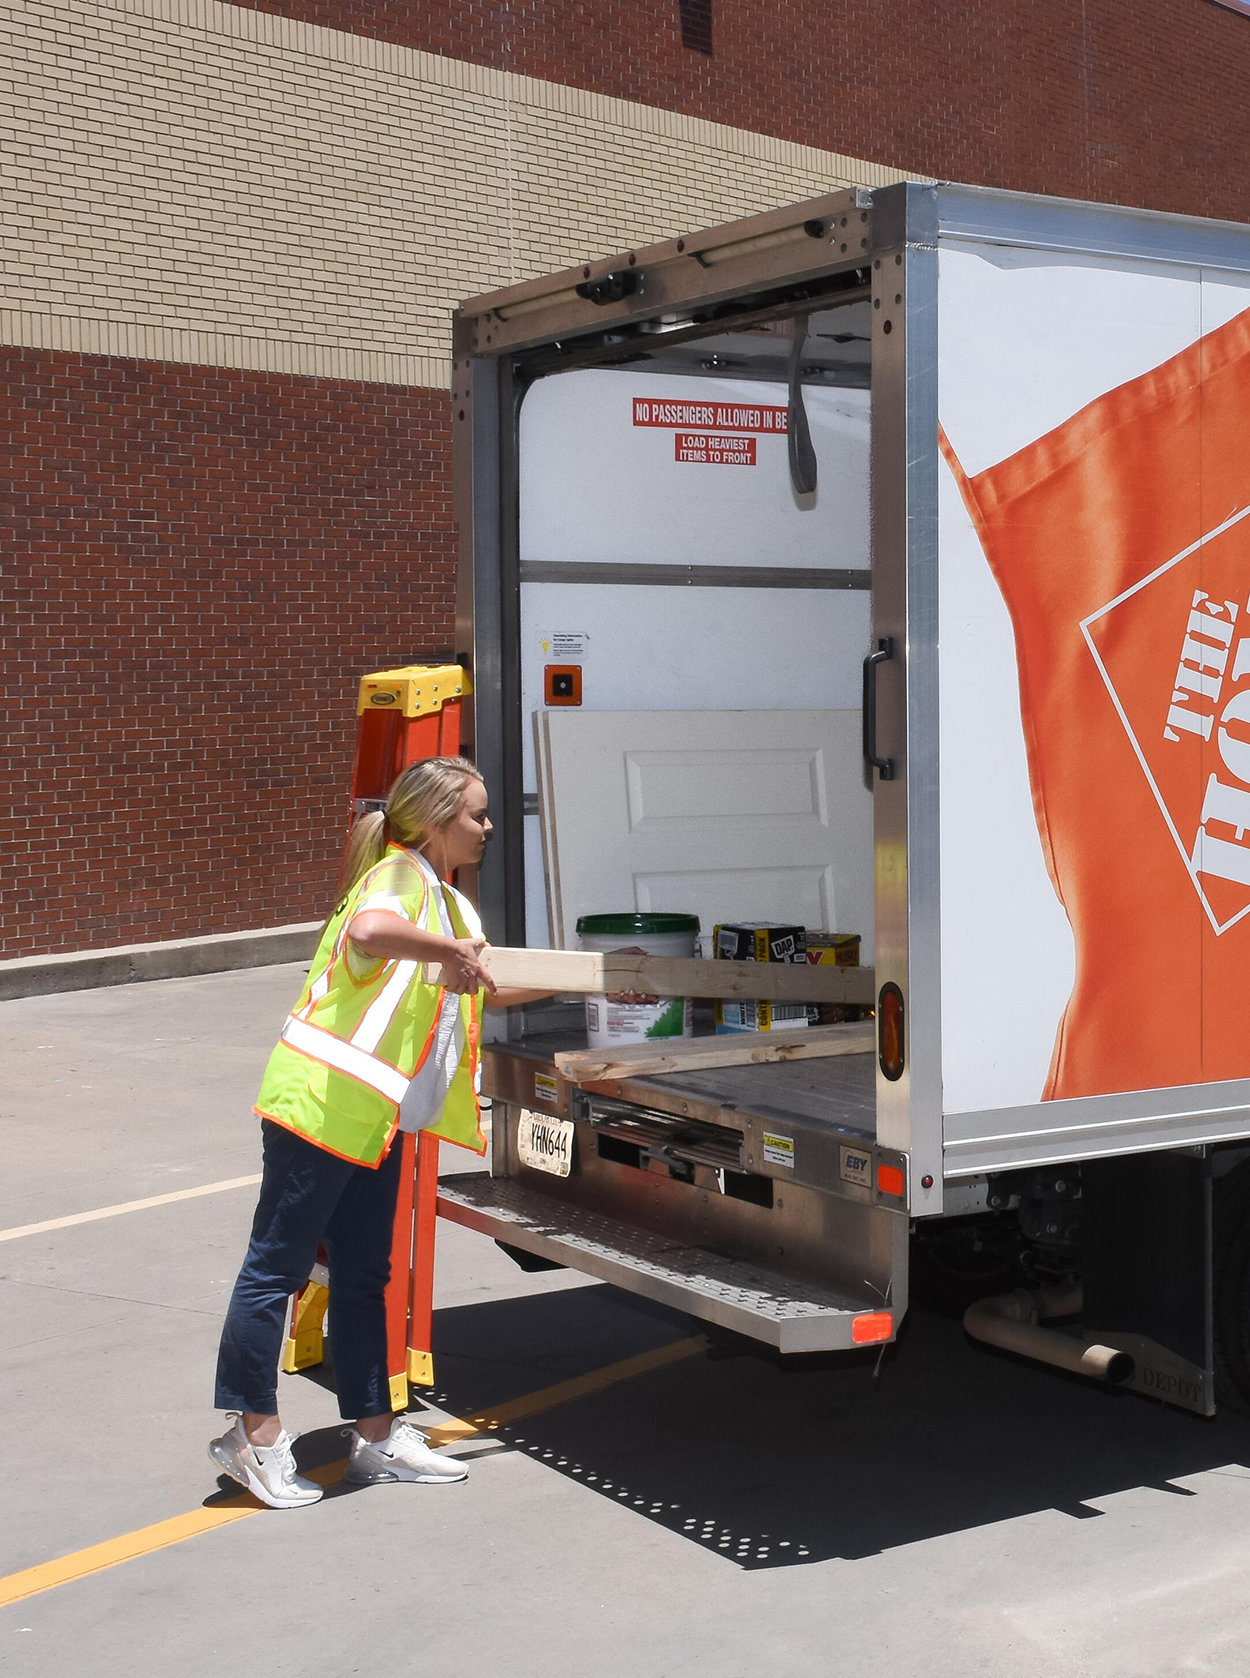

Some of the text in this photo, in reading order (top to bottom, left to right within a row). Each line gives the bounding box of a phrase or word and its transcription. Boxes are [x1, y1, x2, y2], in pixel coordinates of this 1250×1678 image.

[636, 403, 788, 429] NO PASSENGERS ALLOWED IN BE
[682, 436, 749, 450] LOAD HEAVIEST
[680, 449, 751, 464] ITEMS TO FRONT
[1163, 589, 1239, 743] THE
[757, 936, 767, 960] PACK
[774, 940, 793, 957] DAP
[531, 1123, 567, 1161] YHN644
[846, 1154, 868, 1171] EBY
[1143, 1367, 1201, 1402] DEPOT
